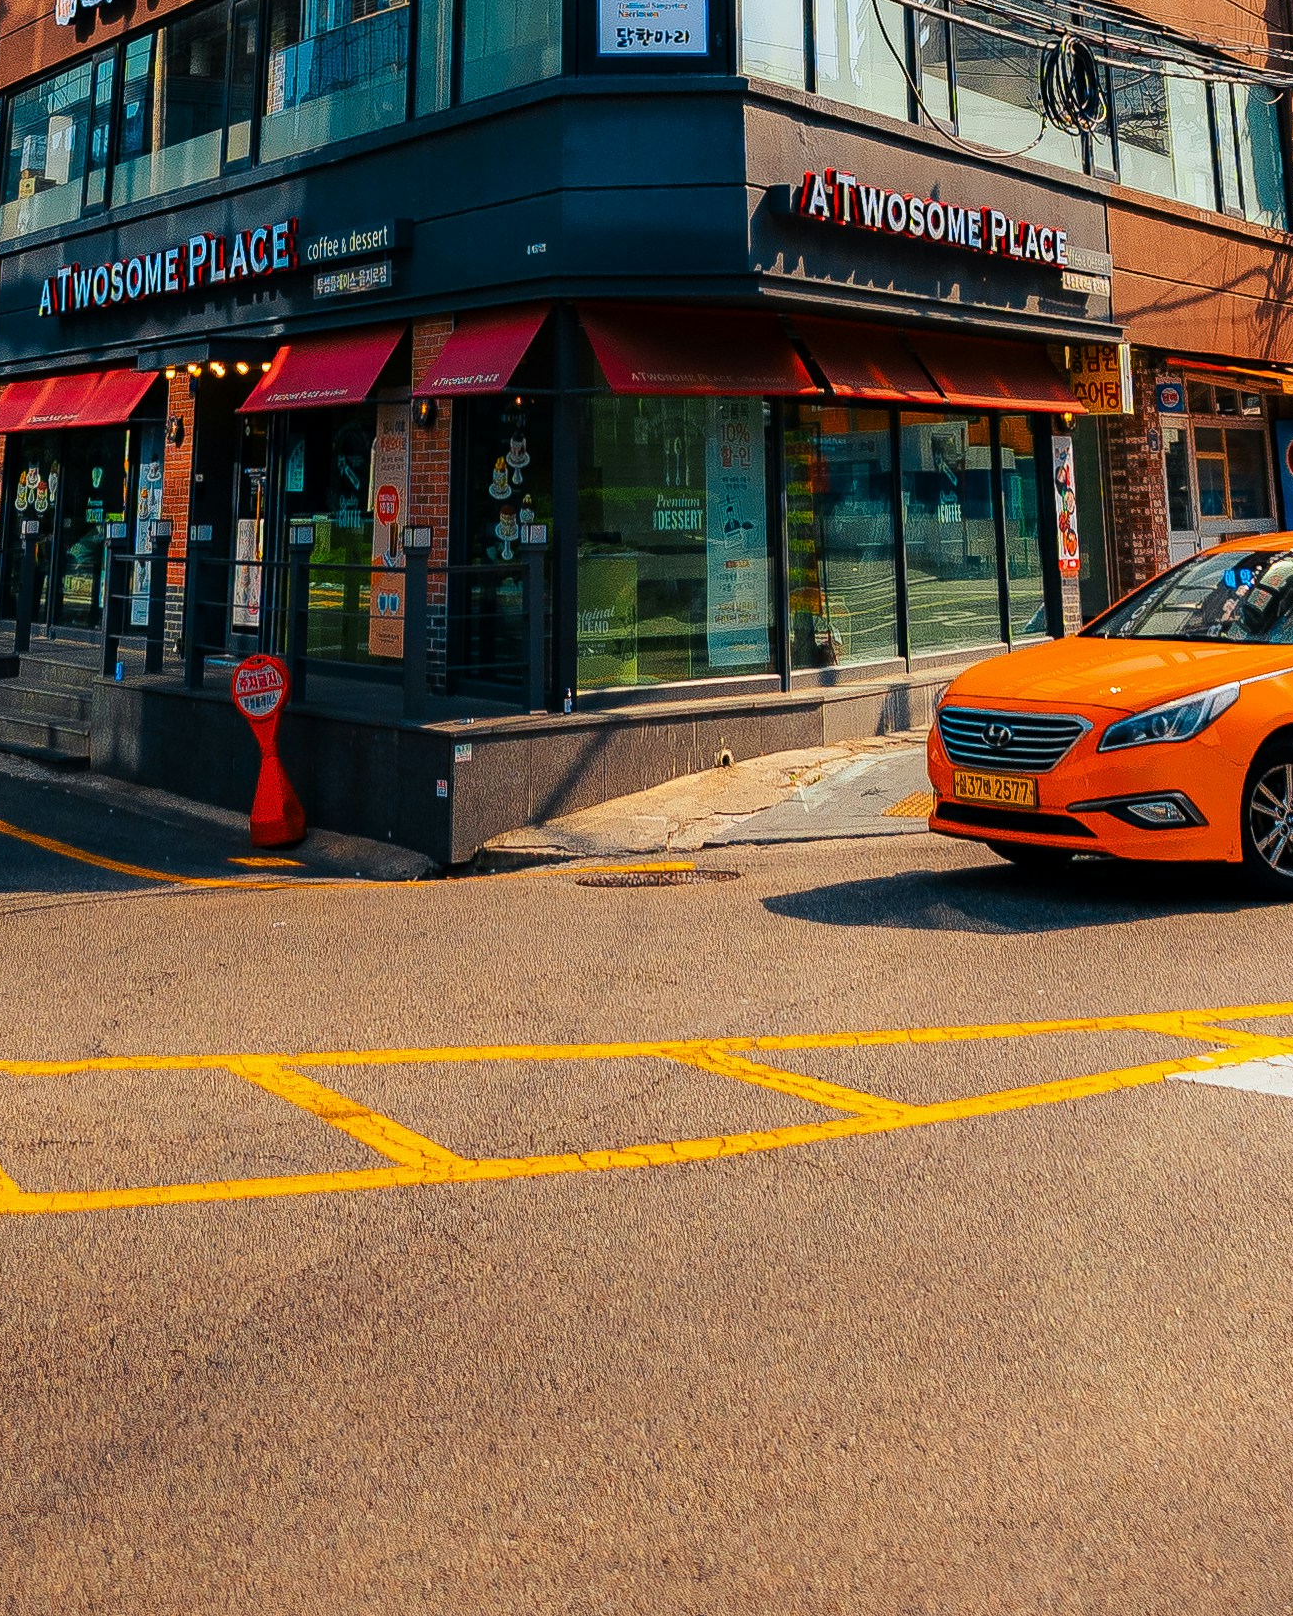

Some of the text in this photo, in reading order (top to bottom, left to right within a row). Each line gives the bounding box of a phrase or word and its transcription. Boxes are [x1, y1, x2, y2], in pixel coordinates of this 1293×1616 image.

[615, 27, 691, 48] 닭한마리
[808, 171, 1068, 265] A TWOSOME PLACE
[307, 225, 388, 261] coffee & dessert
[39, 220, 290, 317] A TWOSOME PLACE
[1086, 344, 1119, 373] 남원
[720, 423, 751, 443] 10%
[721, 445, 751, 469] 할인
[656, 494, 700, 507] Premium
[657, 510, 704, 530] DESSERT
[994, 778, 1030, 803] 2577
